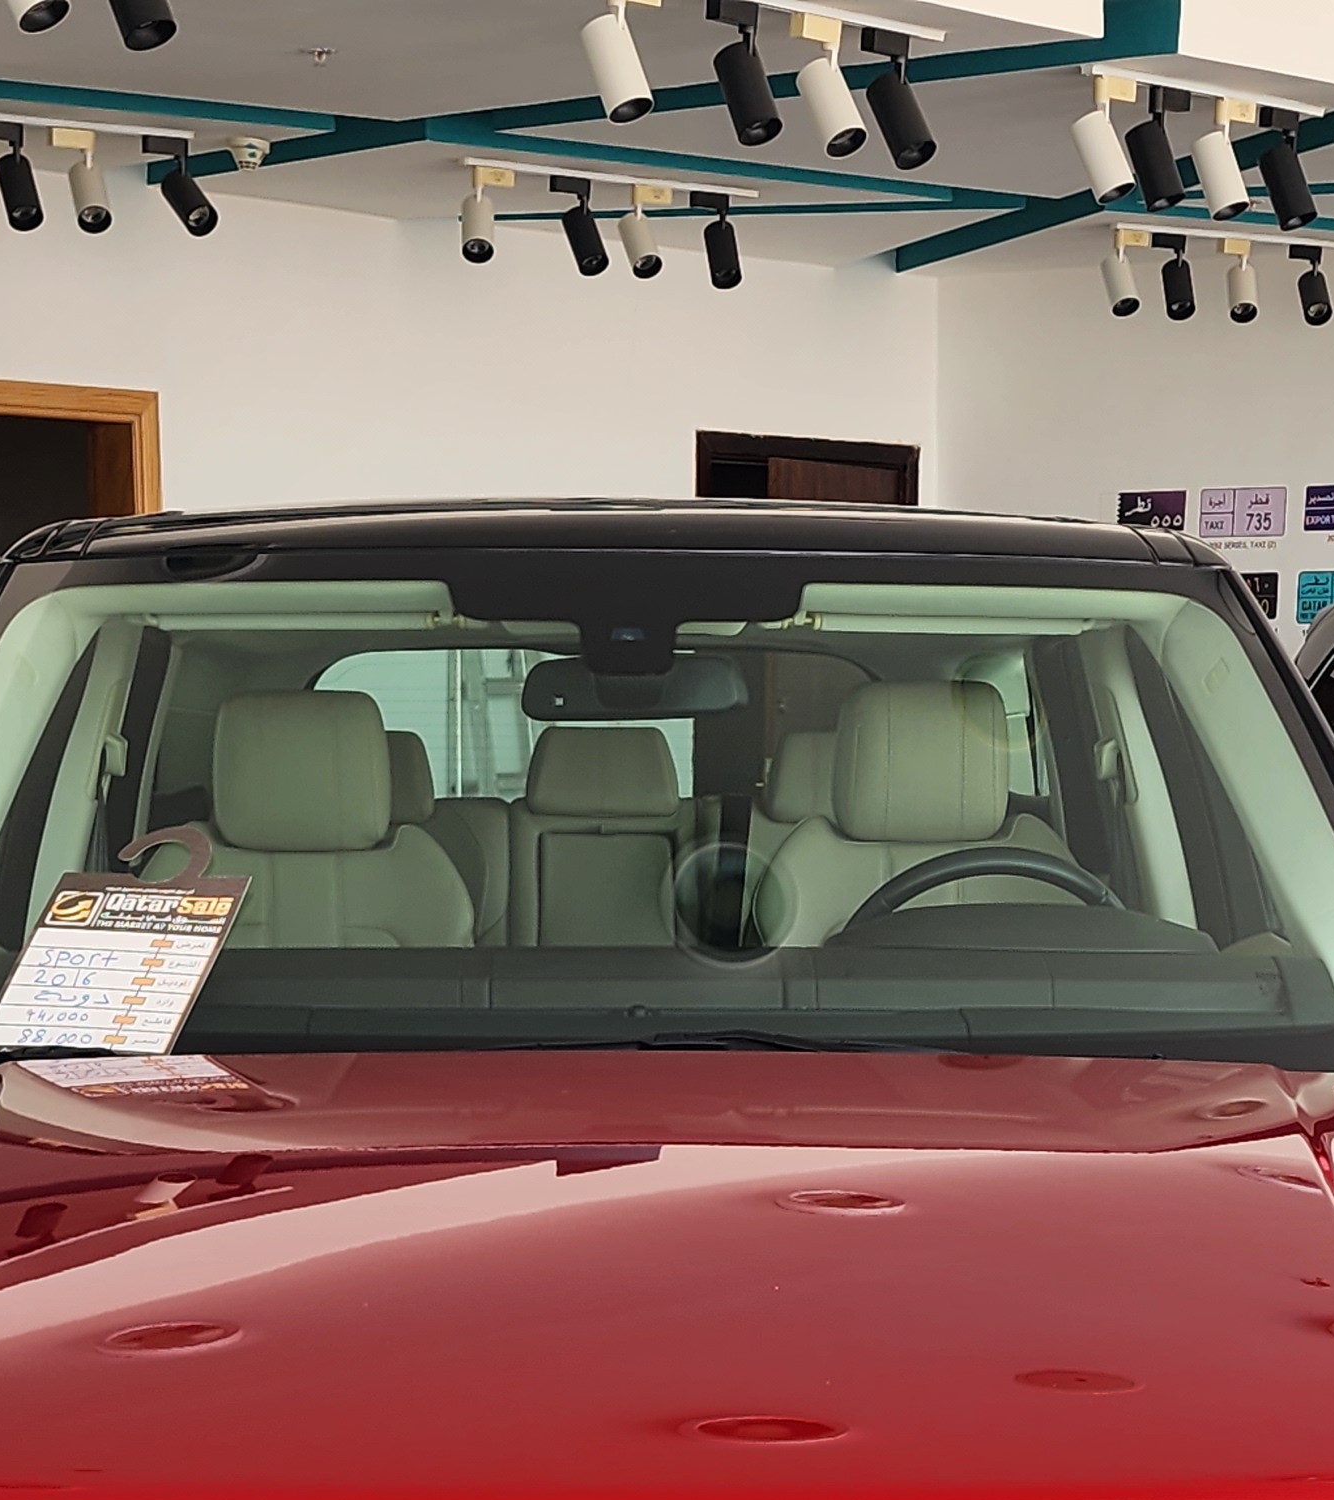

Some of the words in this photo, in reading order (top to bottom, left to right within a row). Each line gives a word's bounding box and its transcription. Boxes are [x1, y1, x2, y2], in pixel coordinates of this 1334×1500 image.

[1124, 496, 1152, 517] قطر
[1247, 493, 1271, 509] قطر
[1204, 520, 1225, 530] TAXI
[1245, 512, 1272, 532] 735
[33, 969, 97, 988] 2016
